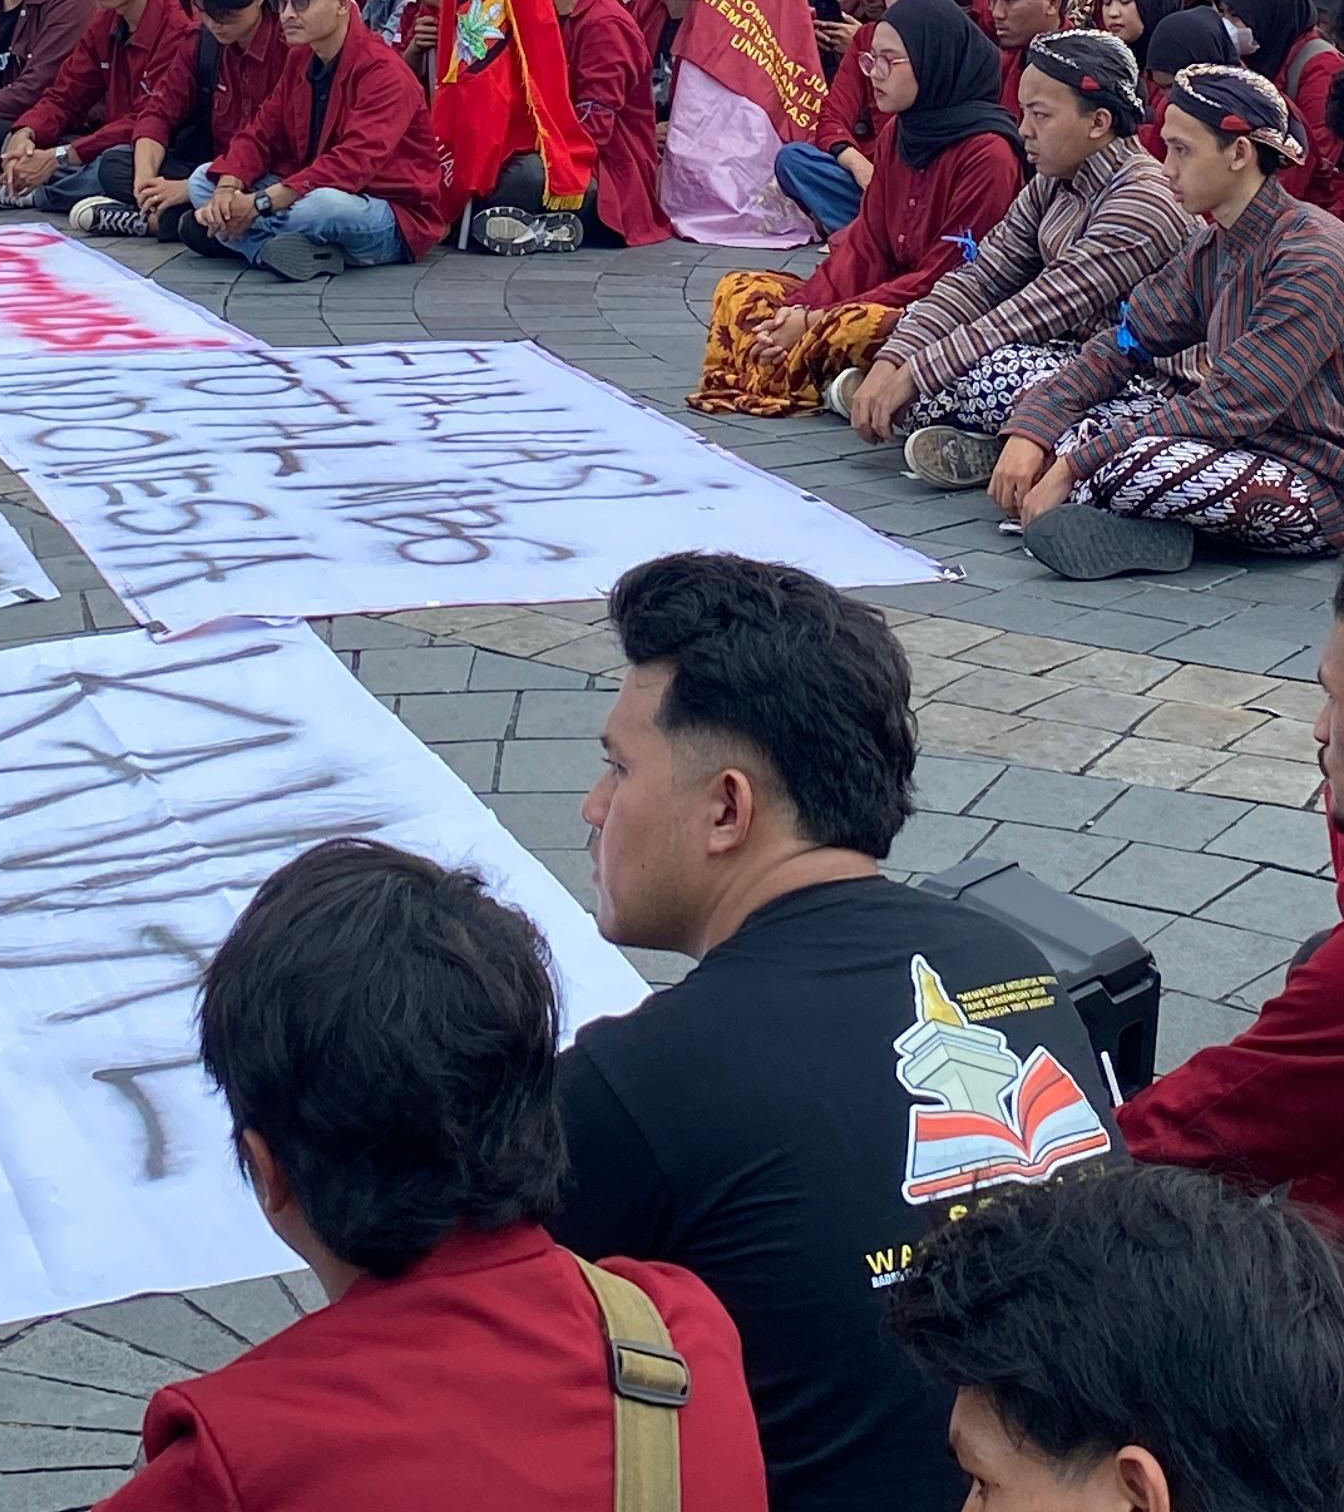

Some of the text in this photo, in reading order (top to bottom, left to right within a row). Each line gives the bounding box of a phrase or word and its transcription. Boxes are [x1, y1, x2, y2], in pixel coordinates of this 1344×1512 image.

[731, 34, 811, 128] UNIVERTAS
[126, 349, 393, 476] TOTAL
[313, 345, 737, 502] EVALUASI
